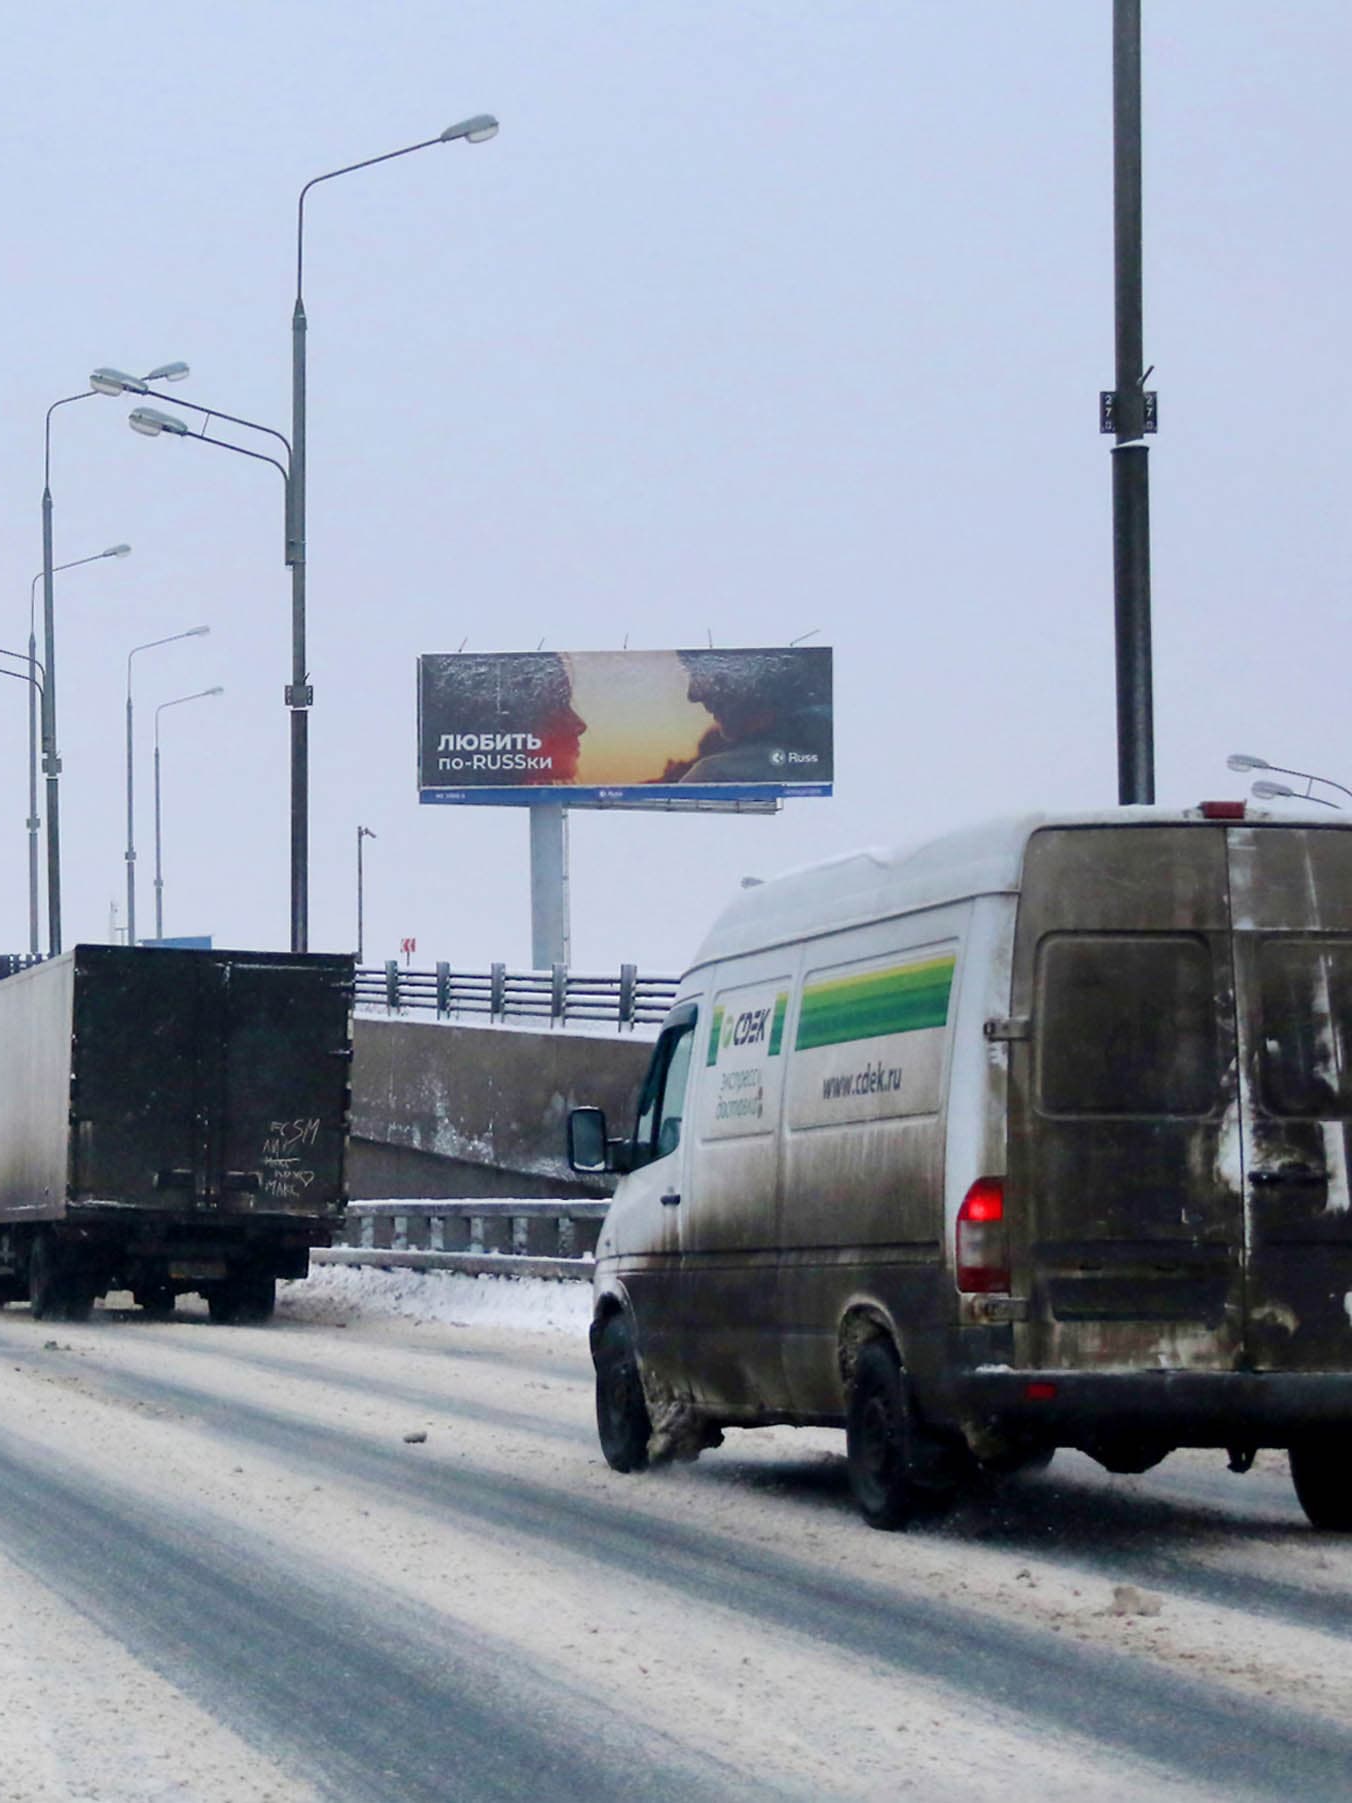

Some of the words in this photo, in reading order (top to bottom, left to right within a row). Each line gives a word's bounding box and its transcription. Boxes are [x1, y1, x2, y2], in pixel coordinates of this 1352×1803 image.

[437, 733, 542, 751] ЛЮБИТЬ
[438, 754, 553, 770] по-RUSSки
[788, 752, 818, 763] Russ
[733, 1008, 771, 1046] CDEK
[823, 1061, 902, 1100] www.cdek.ru
